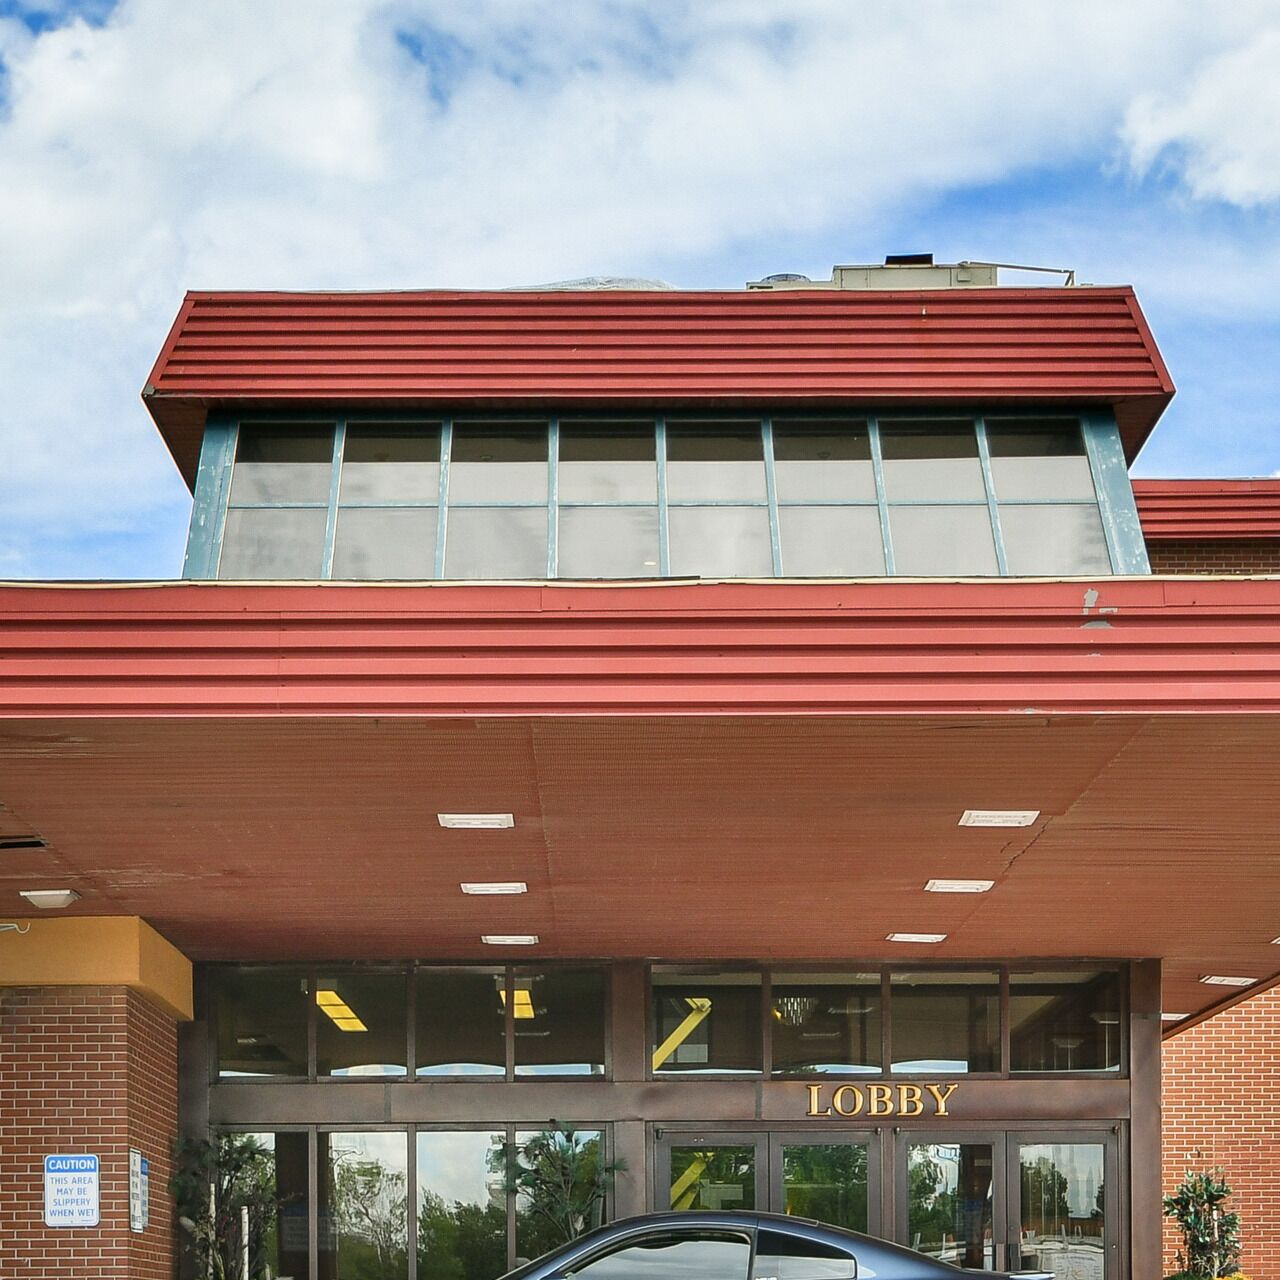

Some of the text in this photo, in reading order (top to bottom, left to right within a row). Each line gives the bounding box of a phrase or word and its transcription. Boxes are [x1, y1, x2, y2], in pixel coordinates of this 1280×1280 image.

[806, 1083, 960, 1117] LOBBY
[48, 1159, 95, 1170] CAUTION
[52, 1198, 91, 1206] SLIPPERY
[50, 1209, 95, 1217] WHEN WET
